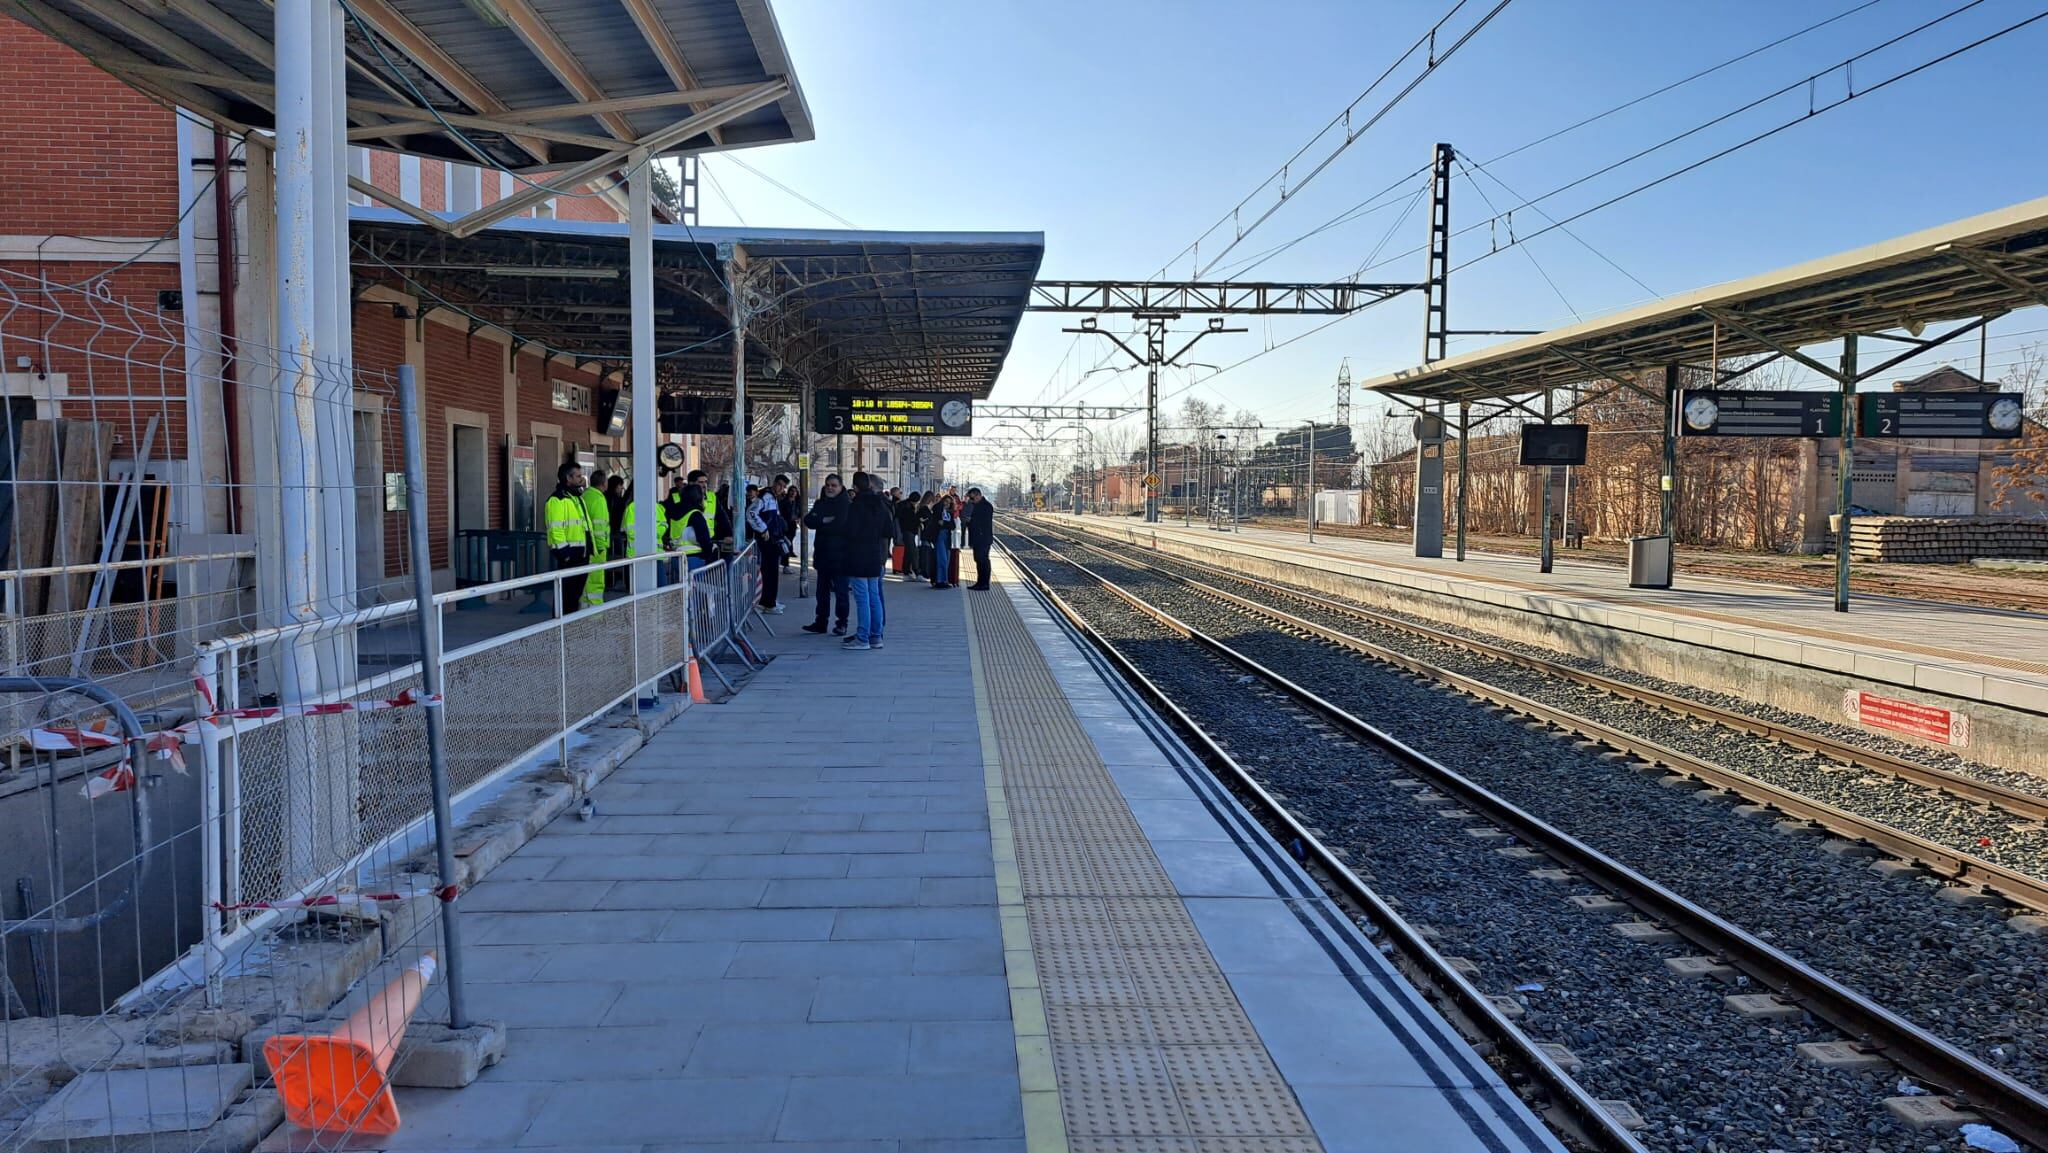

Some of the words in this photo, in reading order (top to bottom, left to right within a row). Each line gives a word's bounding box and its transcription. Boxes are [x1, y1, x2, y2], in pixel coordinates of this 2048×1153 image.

[552, 380, 589, 413] VILENA
[834, 415, 844, 430] 3
[851, 414, 887, 422] VALENCIA
[893, 425, 922, 433] XATIVA
[1815, 418, 1824, 434] 1
[1880, 418, 1892, 434] 2
